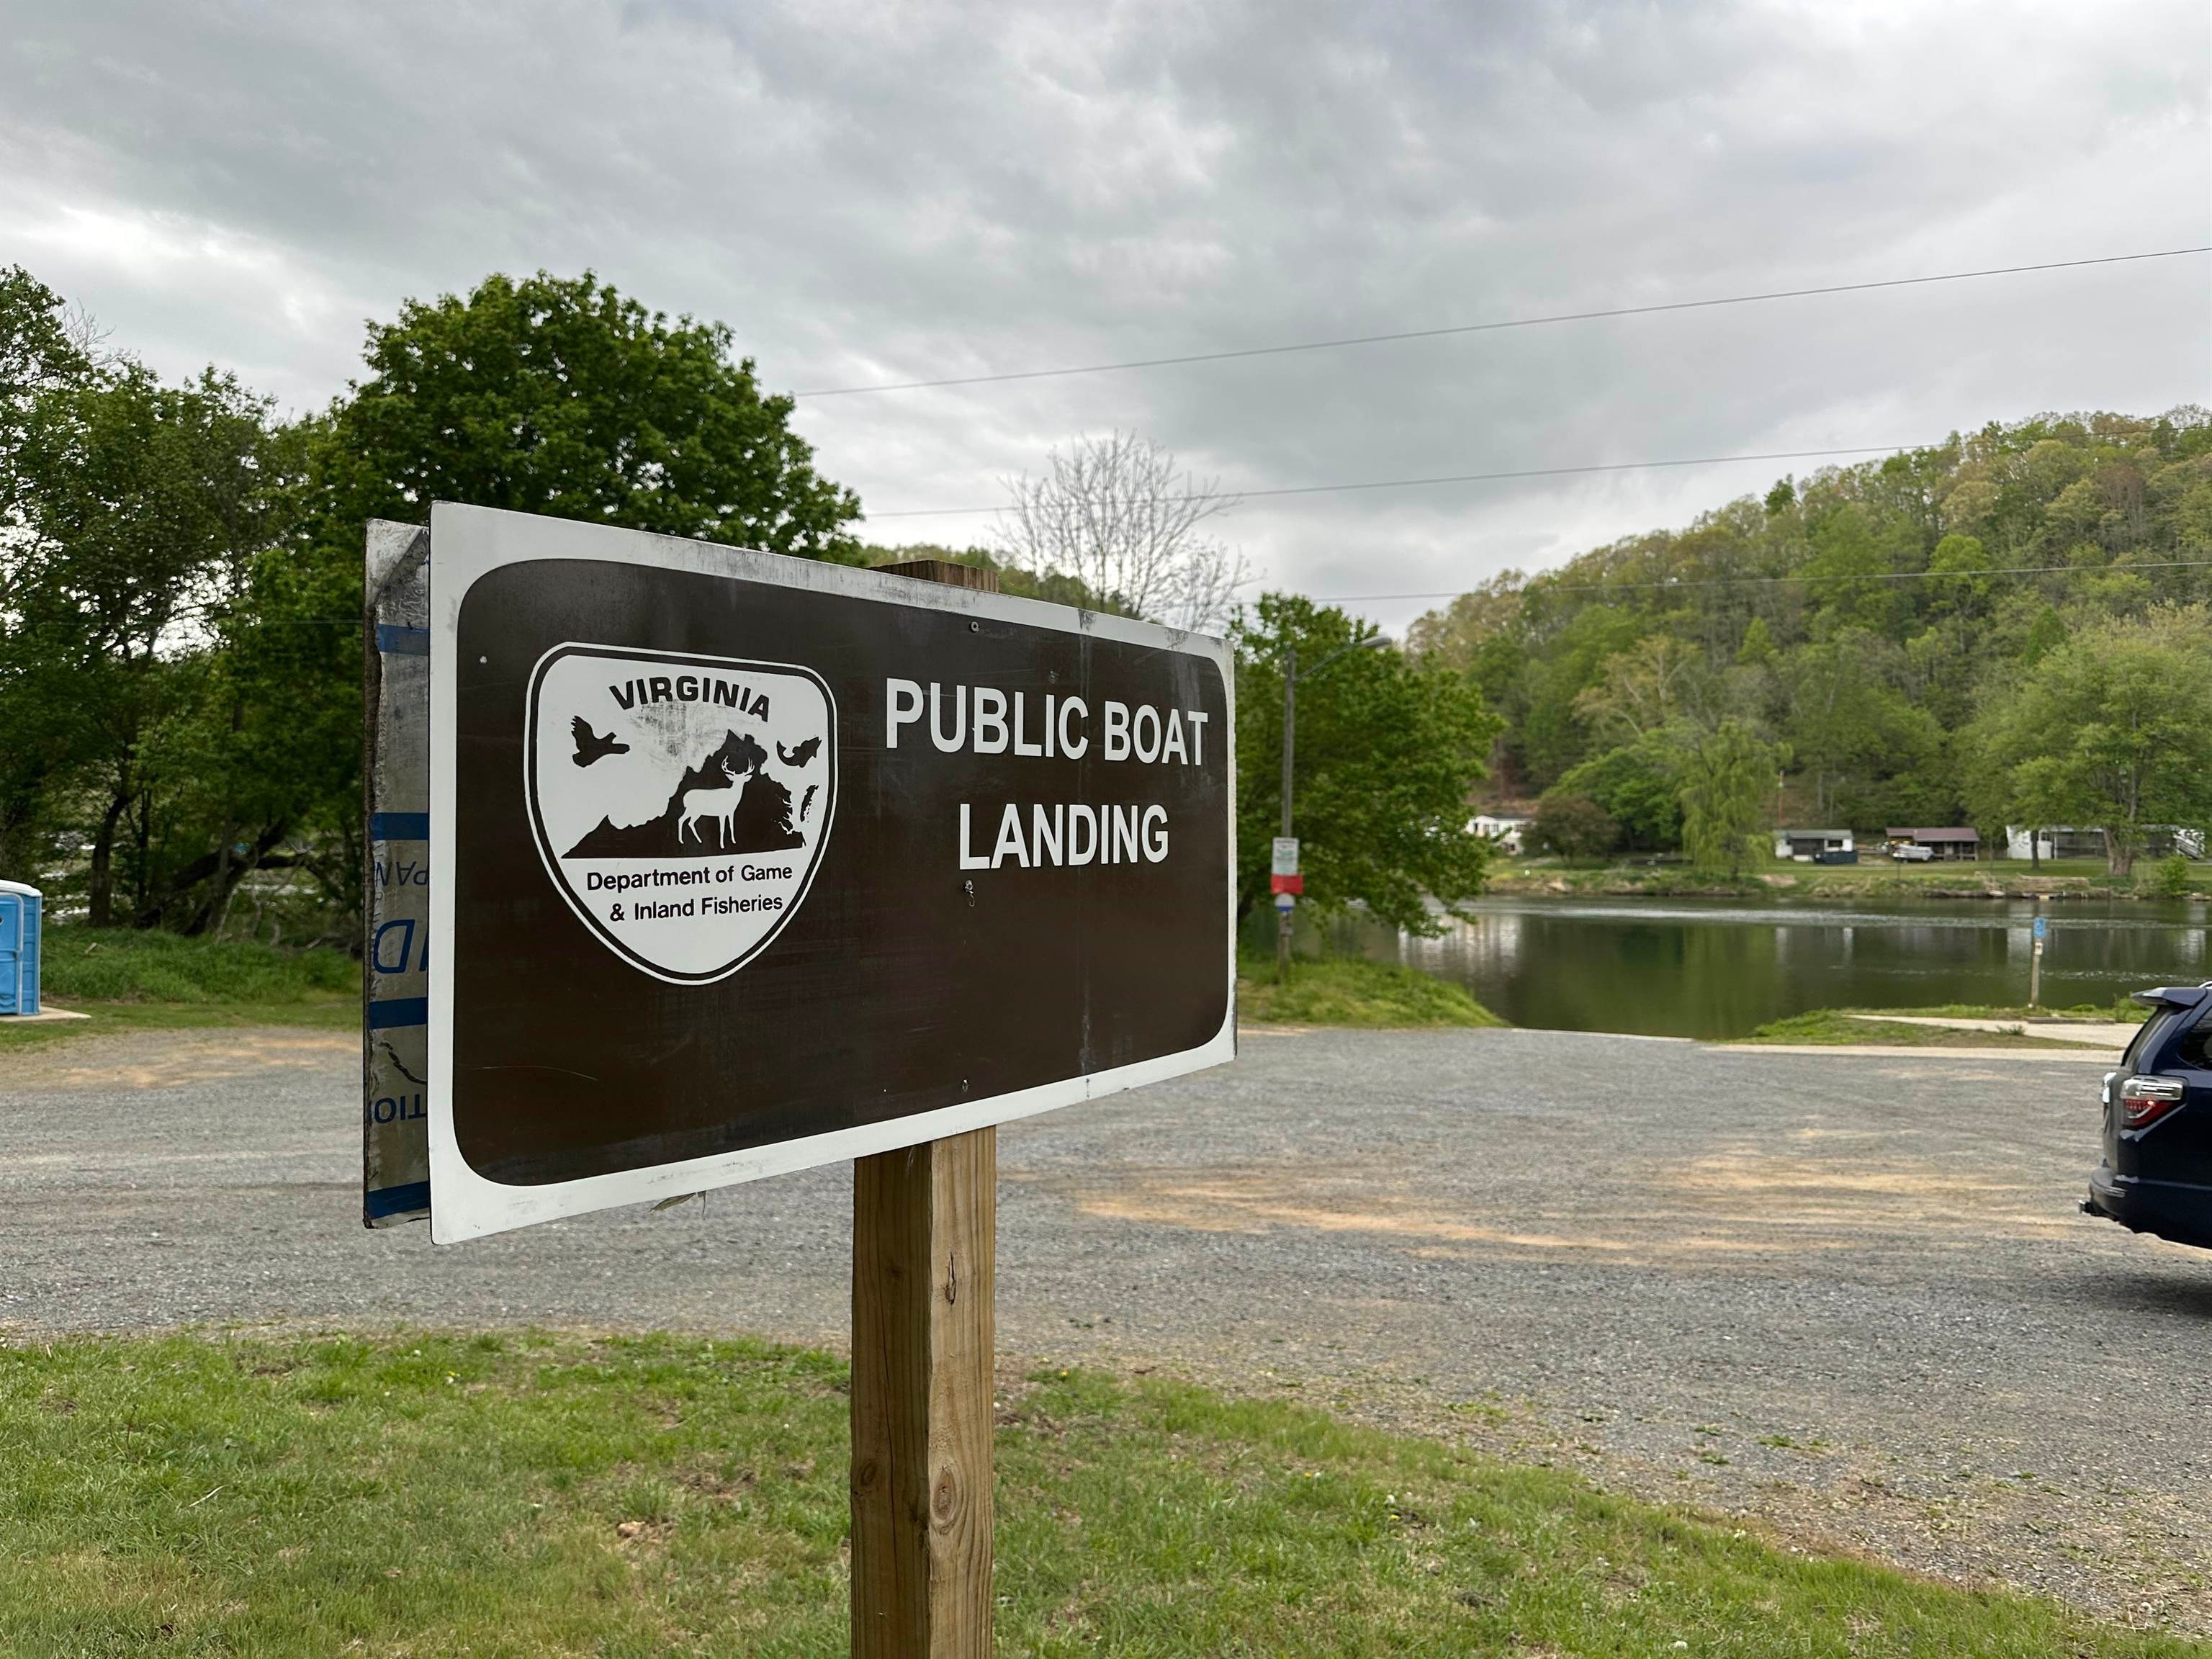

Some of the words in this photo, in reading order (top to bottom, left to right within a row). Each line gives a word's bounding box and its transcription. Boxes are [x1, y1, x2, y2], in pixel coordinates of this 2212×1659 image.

[609, 675, 770, 723] VIRGINIA
[886, 678, 1089, 760] PUBLIC
[1104, 701, 1209, 766] BOAT
[959, 803, 1169, 871] LANDING
[587, 869, 711, 893] Department
[715, 866, 734, 884] of
[740, 864, 793, 882] Game
[609, 904, 626, 922] &
[634, 898, 695, 920] Inland
[701, 894, 783, 917] Fisheries
